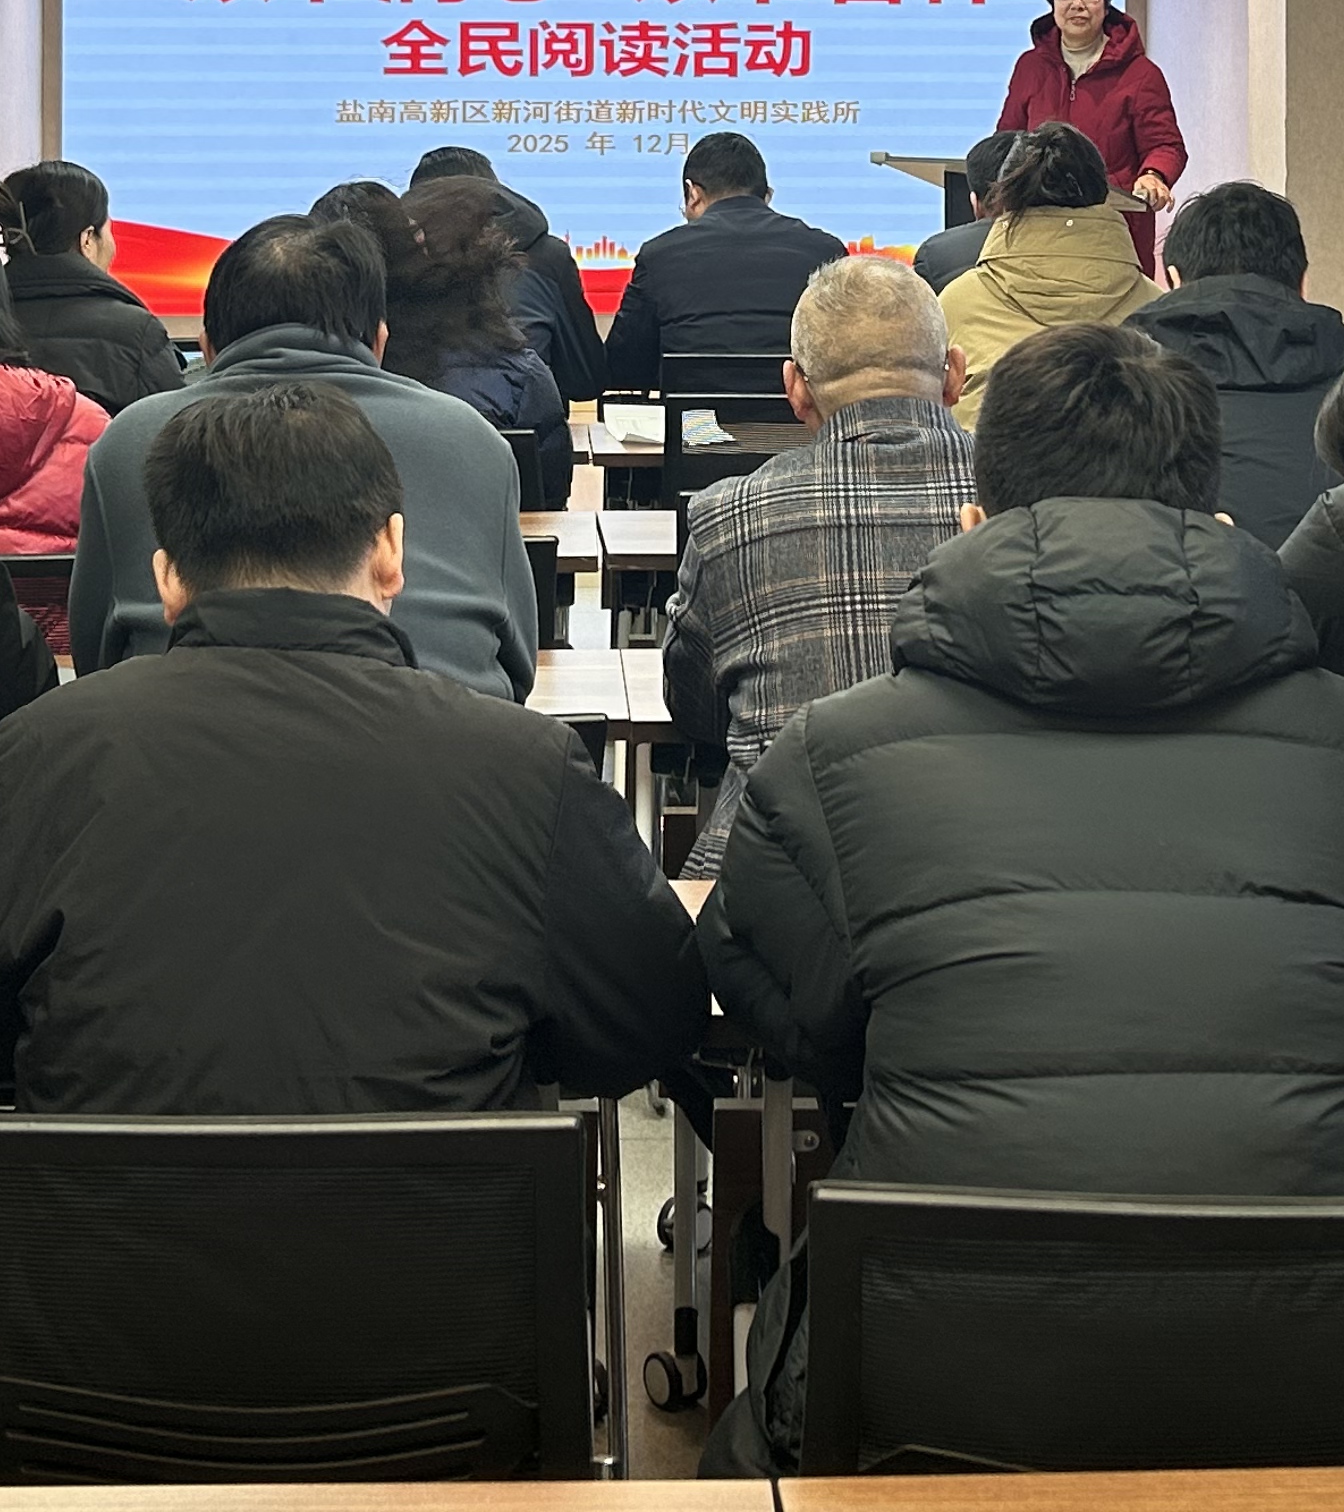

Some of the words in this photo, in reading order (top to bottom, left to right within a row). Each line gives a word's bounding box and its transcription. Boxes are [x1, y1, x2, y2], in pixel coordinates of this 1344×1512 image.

[380, 20, 812, 78] 全民阅读活动
[335, 99, 861, 125] 盐南高新区新河街道新时代文明实践所
[507, 134, 569, 154] 2025
[585, 131, 616, 156] 年
[633, 133, 690, 156] 12月
